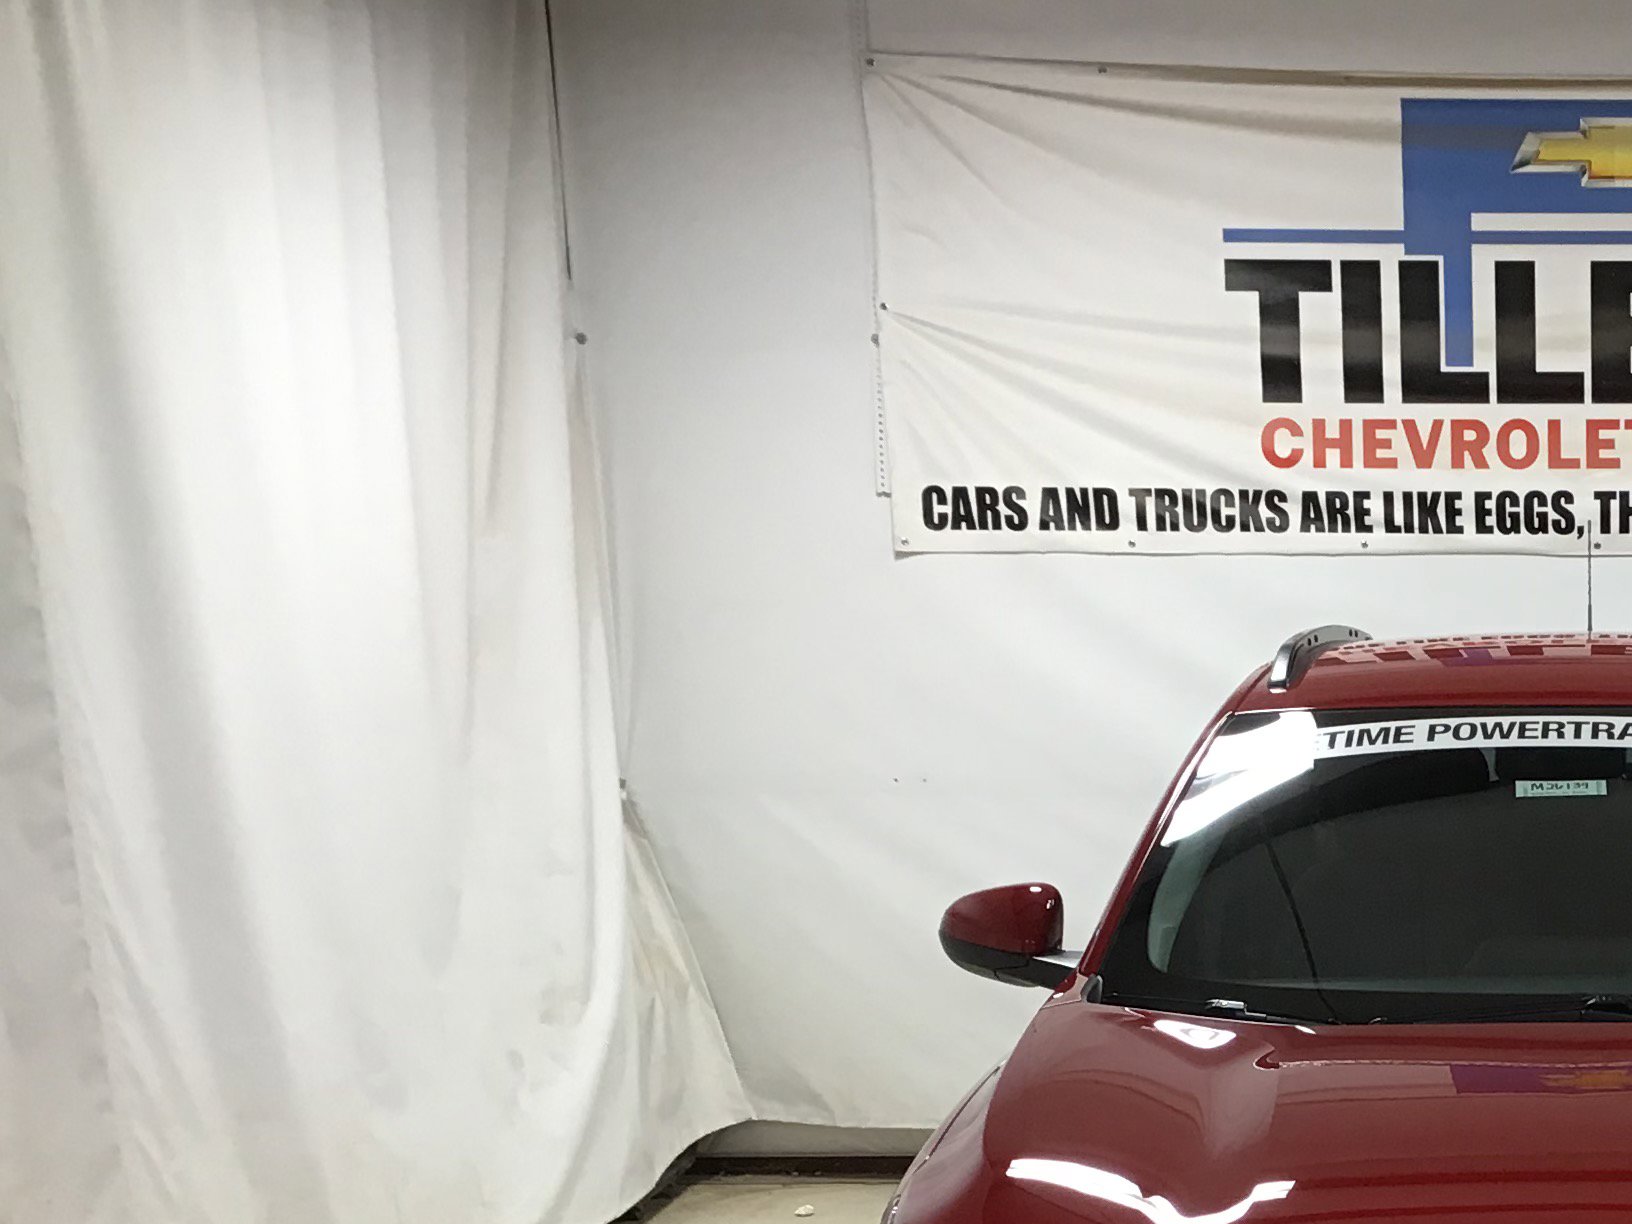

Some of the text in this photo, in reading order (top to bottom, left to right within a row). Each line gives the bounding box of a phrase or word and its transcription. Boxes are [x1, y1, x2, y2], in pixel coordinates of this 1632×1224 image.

[921, 485, 1028, 531] CARS
[1037, 487, 1120, 532] AND
[1129, 488, 1289, 533] TRUCKS
[1301, 490, 1375, 534] ARE
[1383, 491, 1464, 535] LIKE
[1474, 490, 1586, 540] EGGS,
[1314, 725, 1416, 750] TIME
